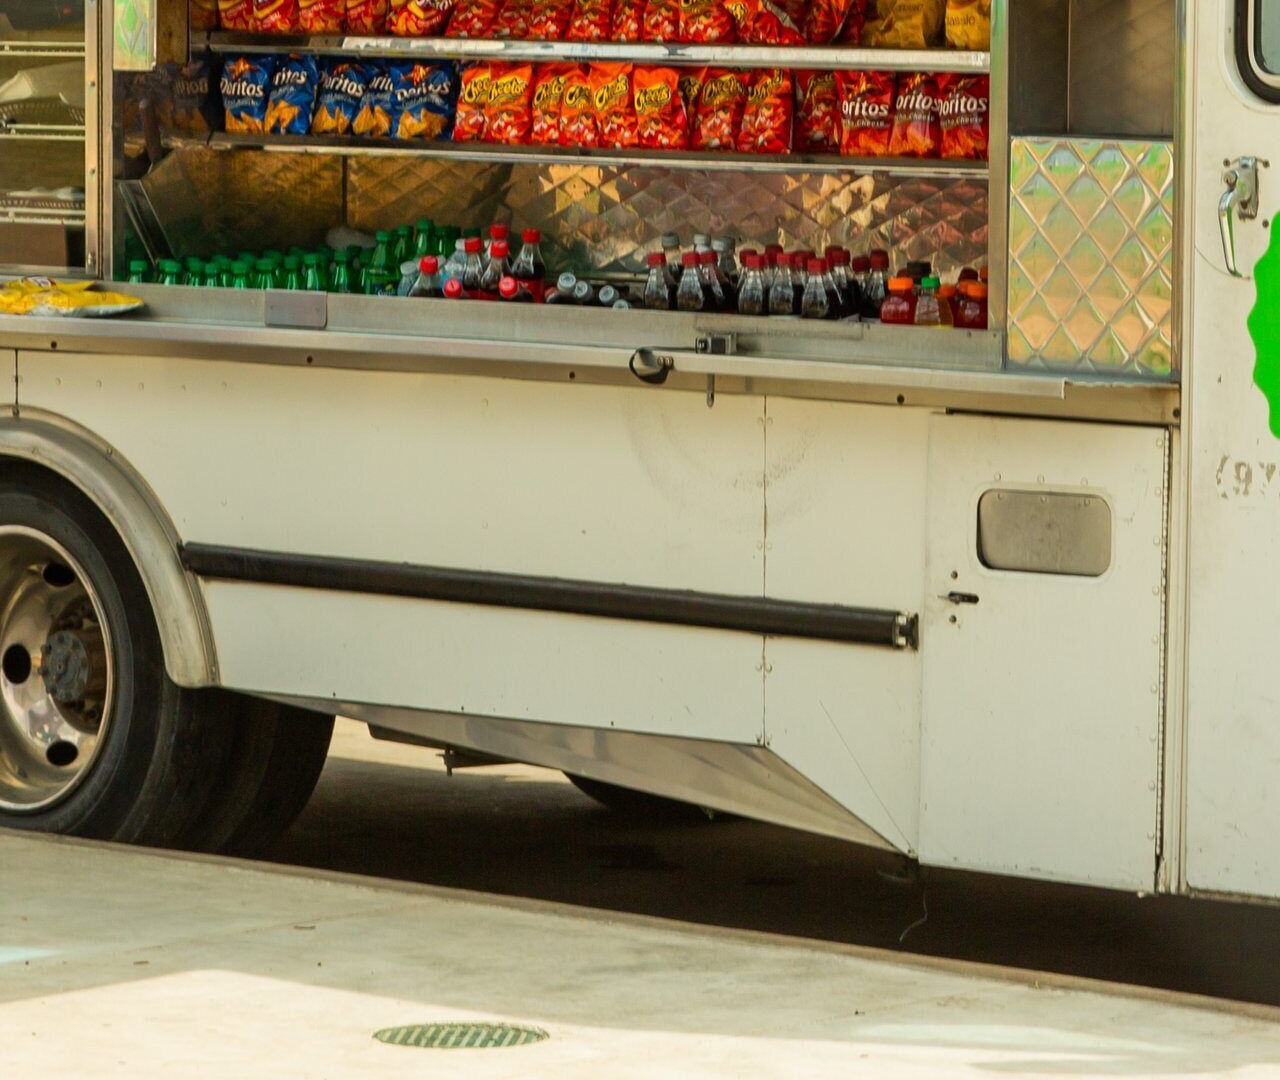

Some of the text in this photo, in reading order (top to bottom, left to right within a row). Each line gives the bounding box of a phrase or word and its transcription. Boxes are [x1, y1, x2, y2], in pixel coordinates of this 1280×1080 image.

[220, 76, 264, 97] Doritos
[396, 80, 451, 101] Doritos
[842, 97, 889, 117] oritos
